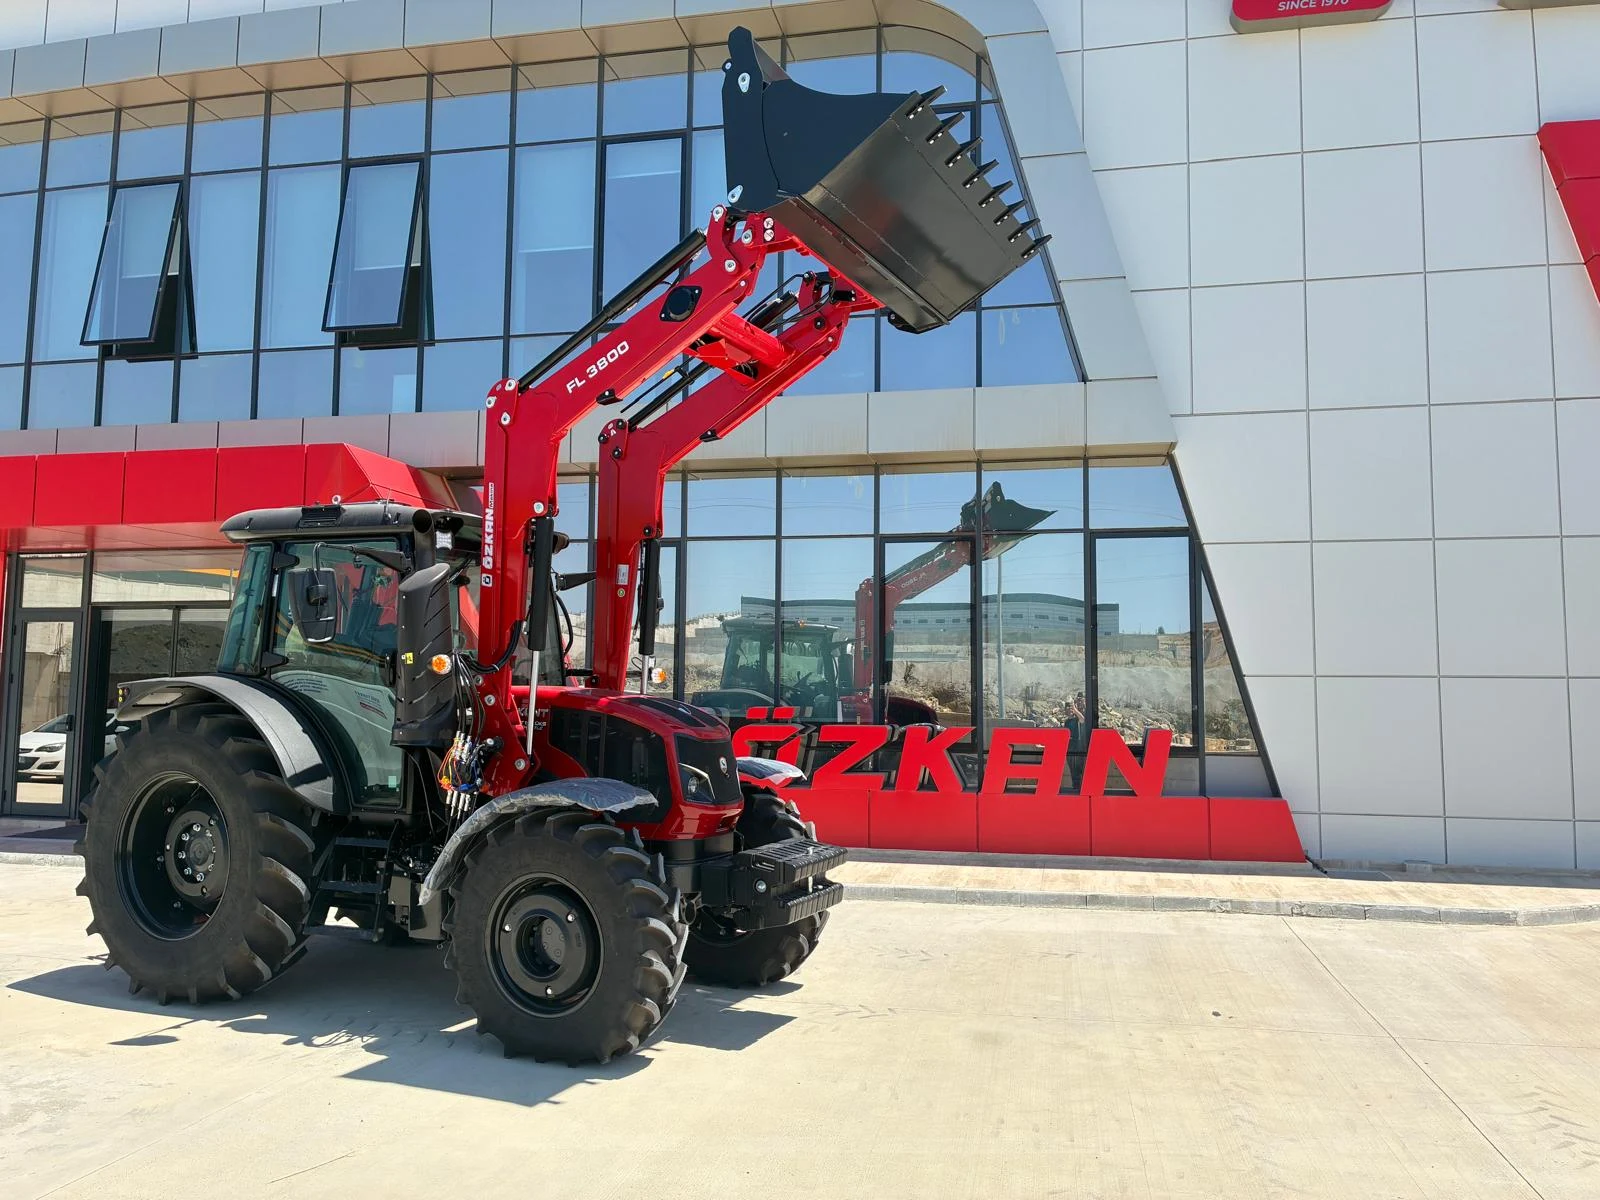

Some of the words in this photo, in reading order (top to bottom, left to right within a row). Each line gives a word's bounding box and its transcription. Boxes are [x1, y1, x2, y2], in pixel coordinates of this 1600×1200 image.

[1277, 0, 1317, 11] SINCE
[566, 376, 587, 394] FL
[586, 340, 630, 379] 3800
[482, 507, 495, 569] ÖZKAN
[732, 707, 1173, 797] ÖZKAN
